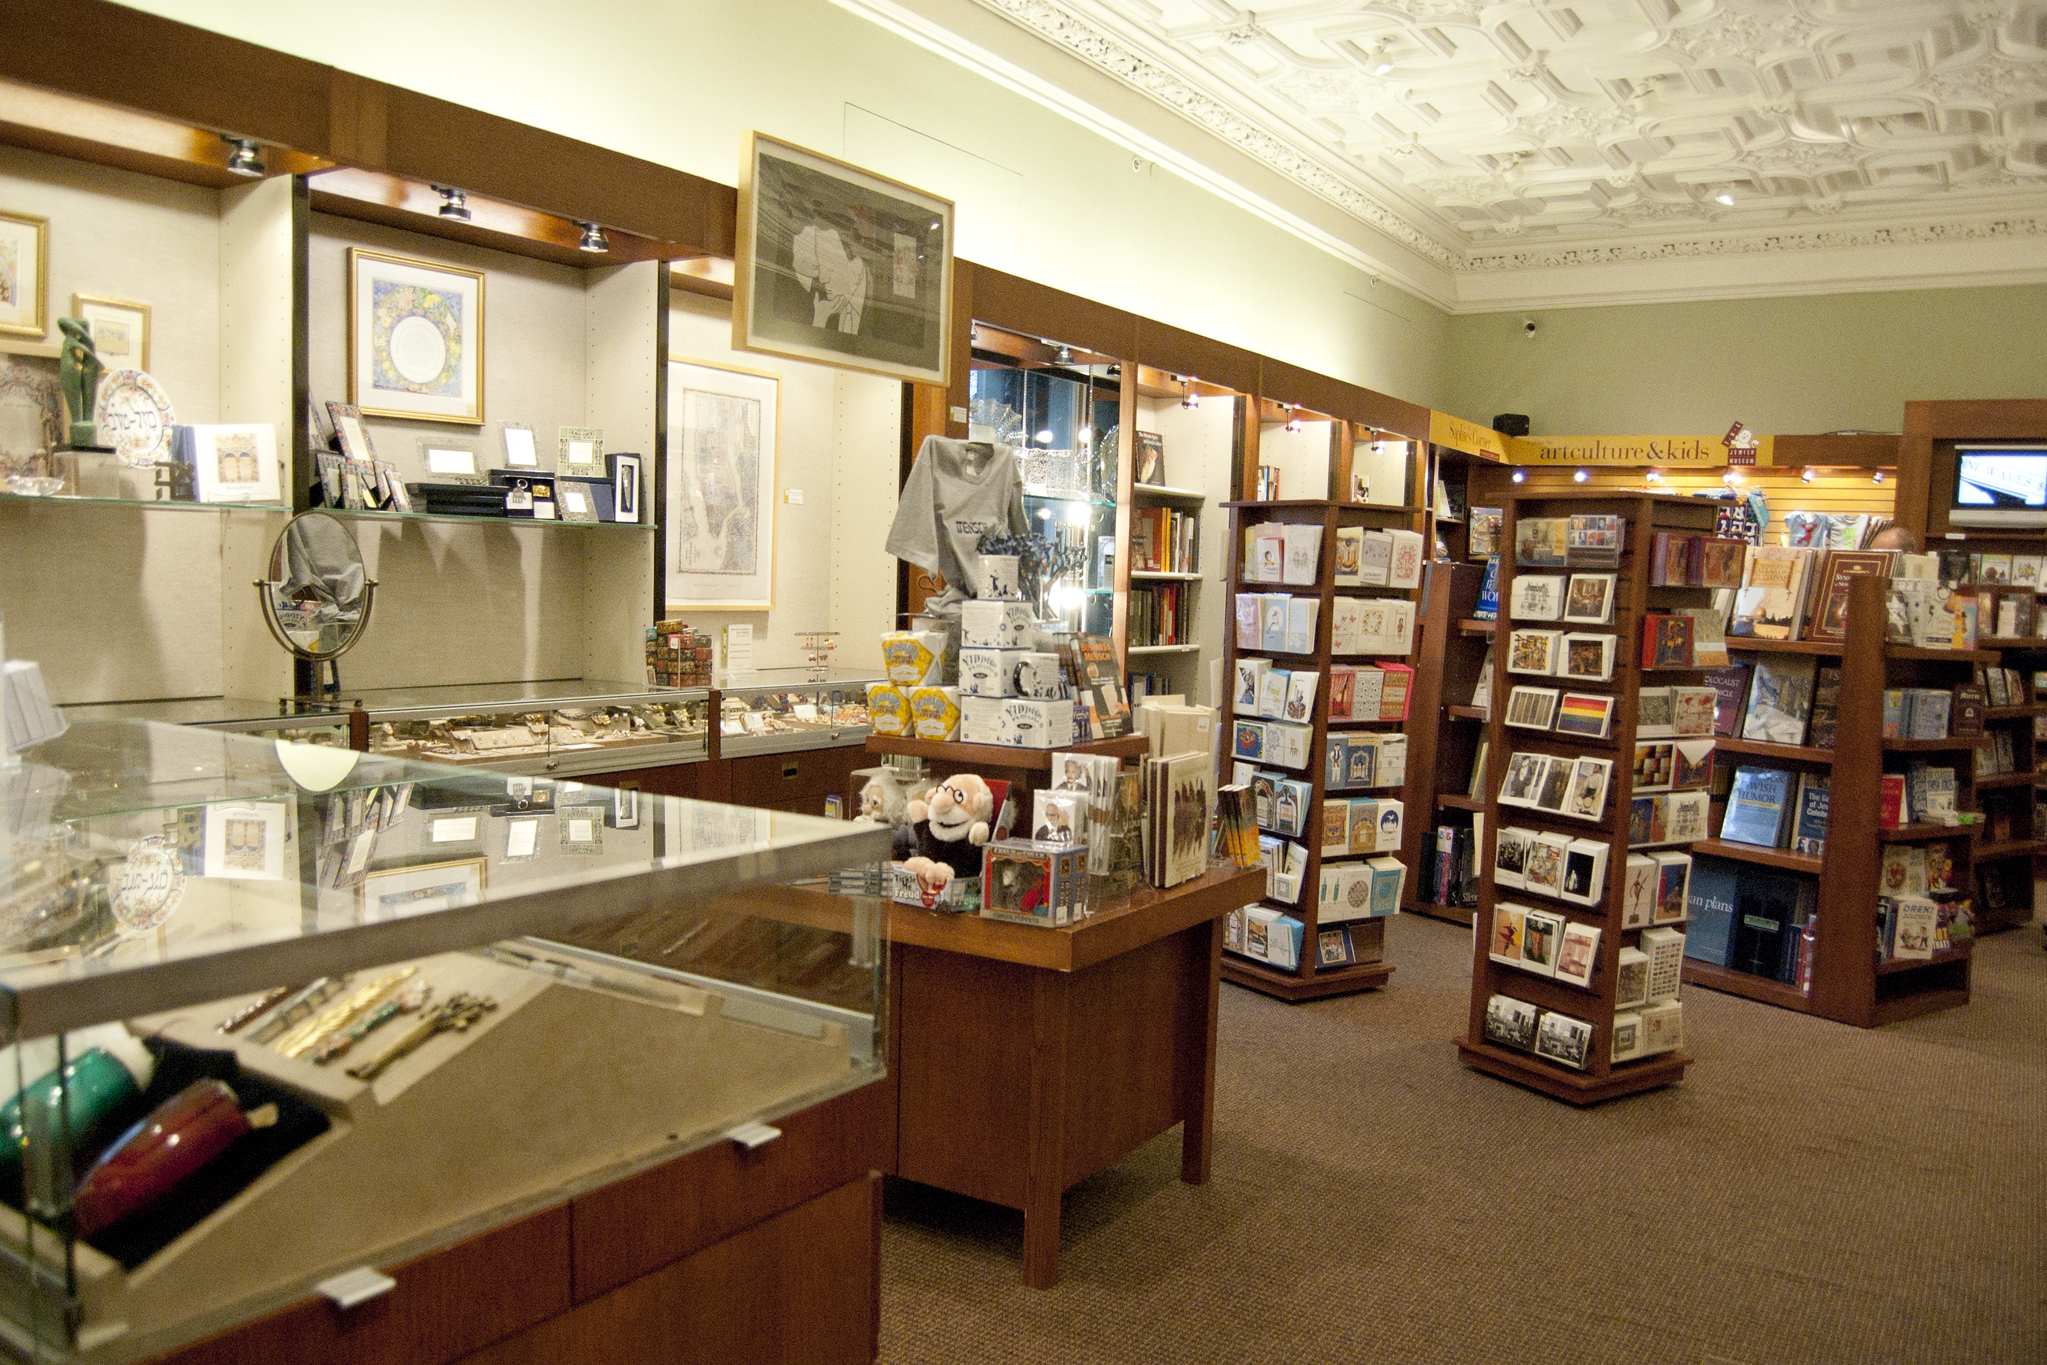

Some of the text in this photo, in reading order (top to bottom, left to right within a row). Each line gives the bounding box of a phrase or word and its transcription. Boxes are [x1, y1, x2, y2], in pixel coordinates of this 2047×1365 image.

[955, 521, 988, 534] MENSC
[1080, 642, 1111, 652] BUSINESS
[962, 654, 998, 669] YIDDISH
[1083, 652, 1112, 661] MENSCH
[1704, 675, 1740, 688] OLOCAUST
[1005, 704, 1043, 719] YIDDISH
[1736, 788, 1777, 804] HUMOR
[1808, 792, 1820, 802] The
[895, 874, 916, 883] Tickle
[894, 887, 920, 899] Freud
[1704, 896, 1734, 914] plans
